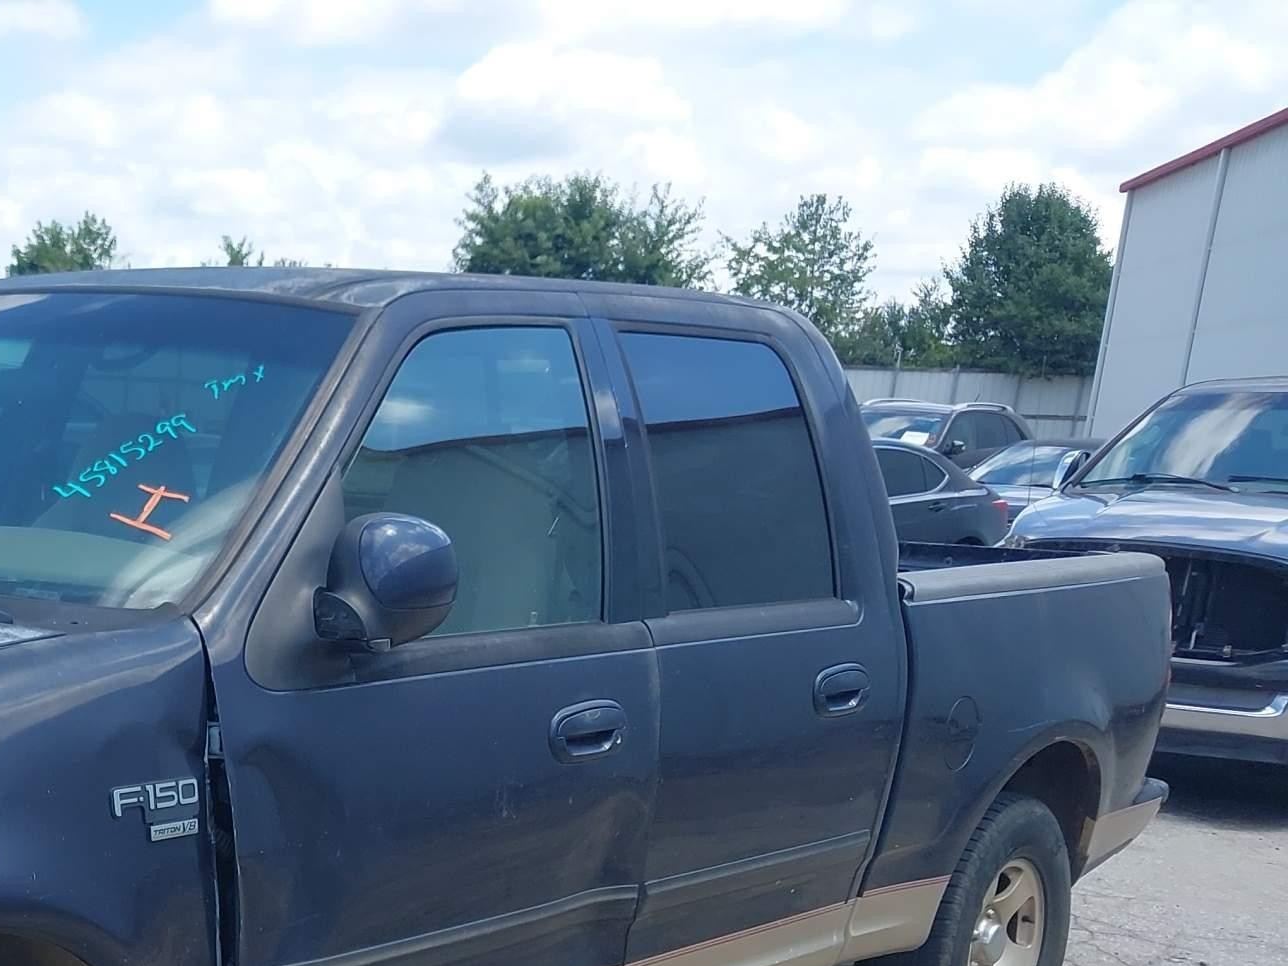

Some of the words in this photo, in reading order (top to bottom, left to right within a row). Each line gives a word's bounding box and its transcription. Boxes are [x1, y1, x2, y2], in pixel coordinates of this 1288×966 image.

[52, 413, 197, 498] 45815299
[152, 826, 182, 837] TRITON
[182, 821, 197, 834] V8
